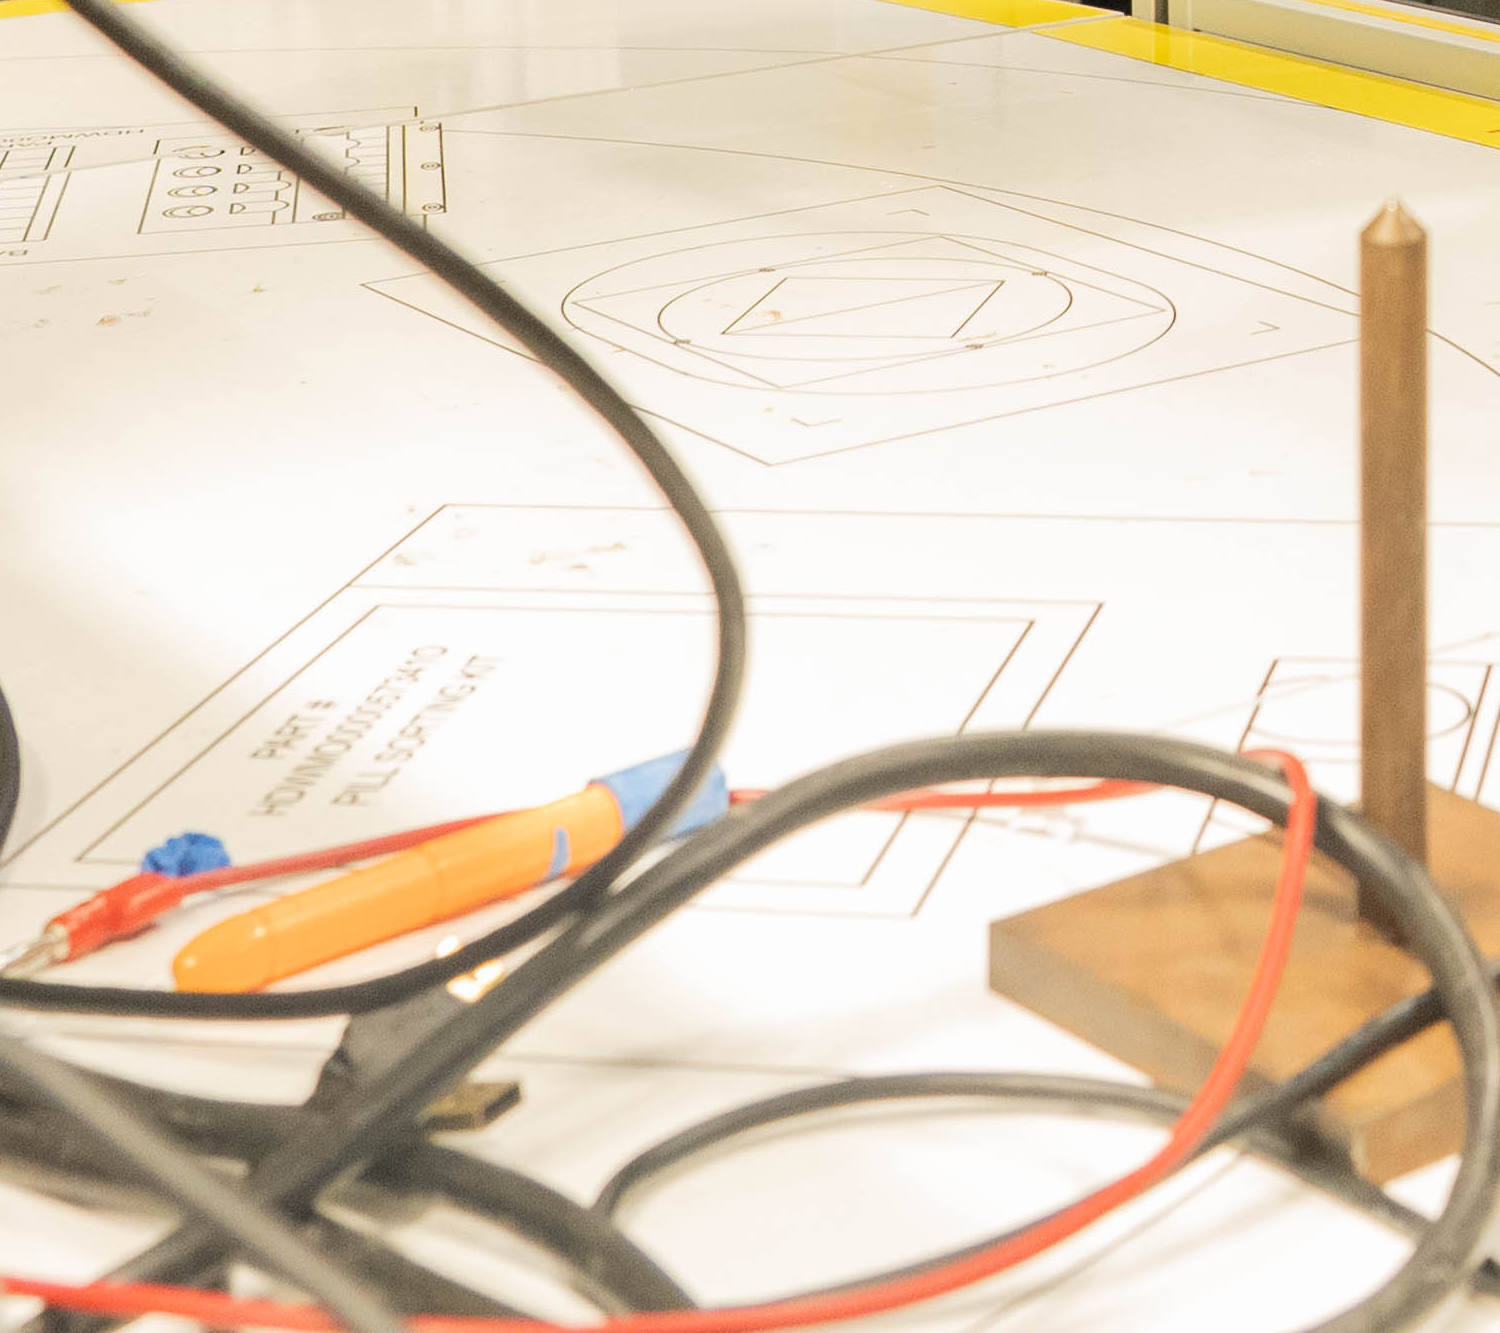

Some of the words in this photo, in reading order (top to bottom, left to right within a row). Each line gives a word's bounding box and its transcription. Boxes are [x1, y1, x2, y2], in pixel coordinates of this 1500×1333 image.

[249, 714, 324, 761] PART
[331, 767, 400, 807] PILL
[373, 683, 477, 763] SORTING
[460, 653, 505, 680] KIT
